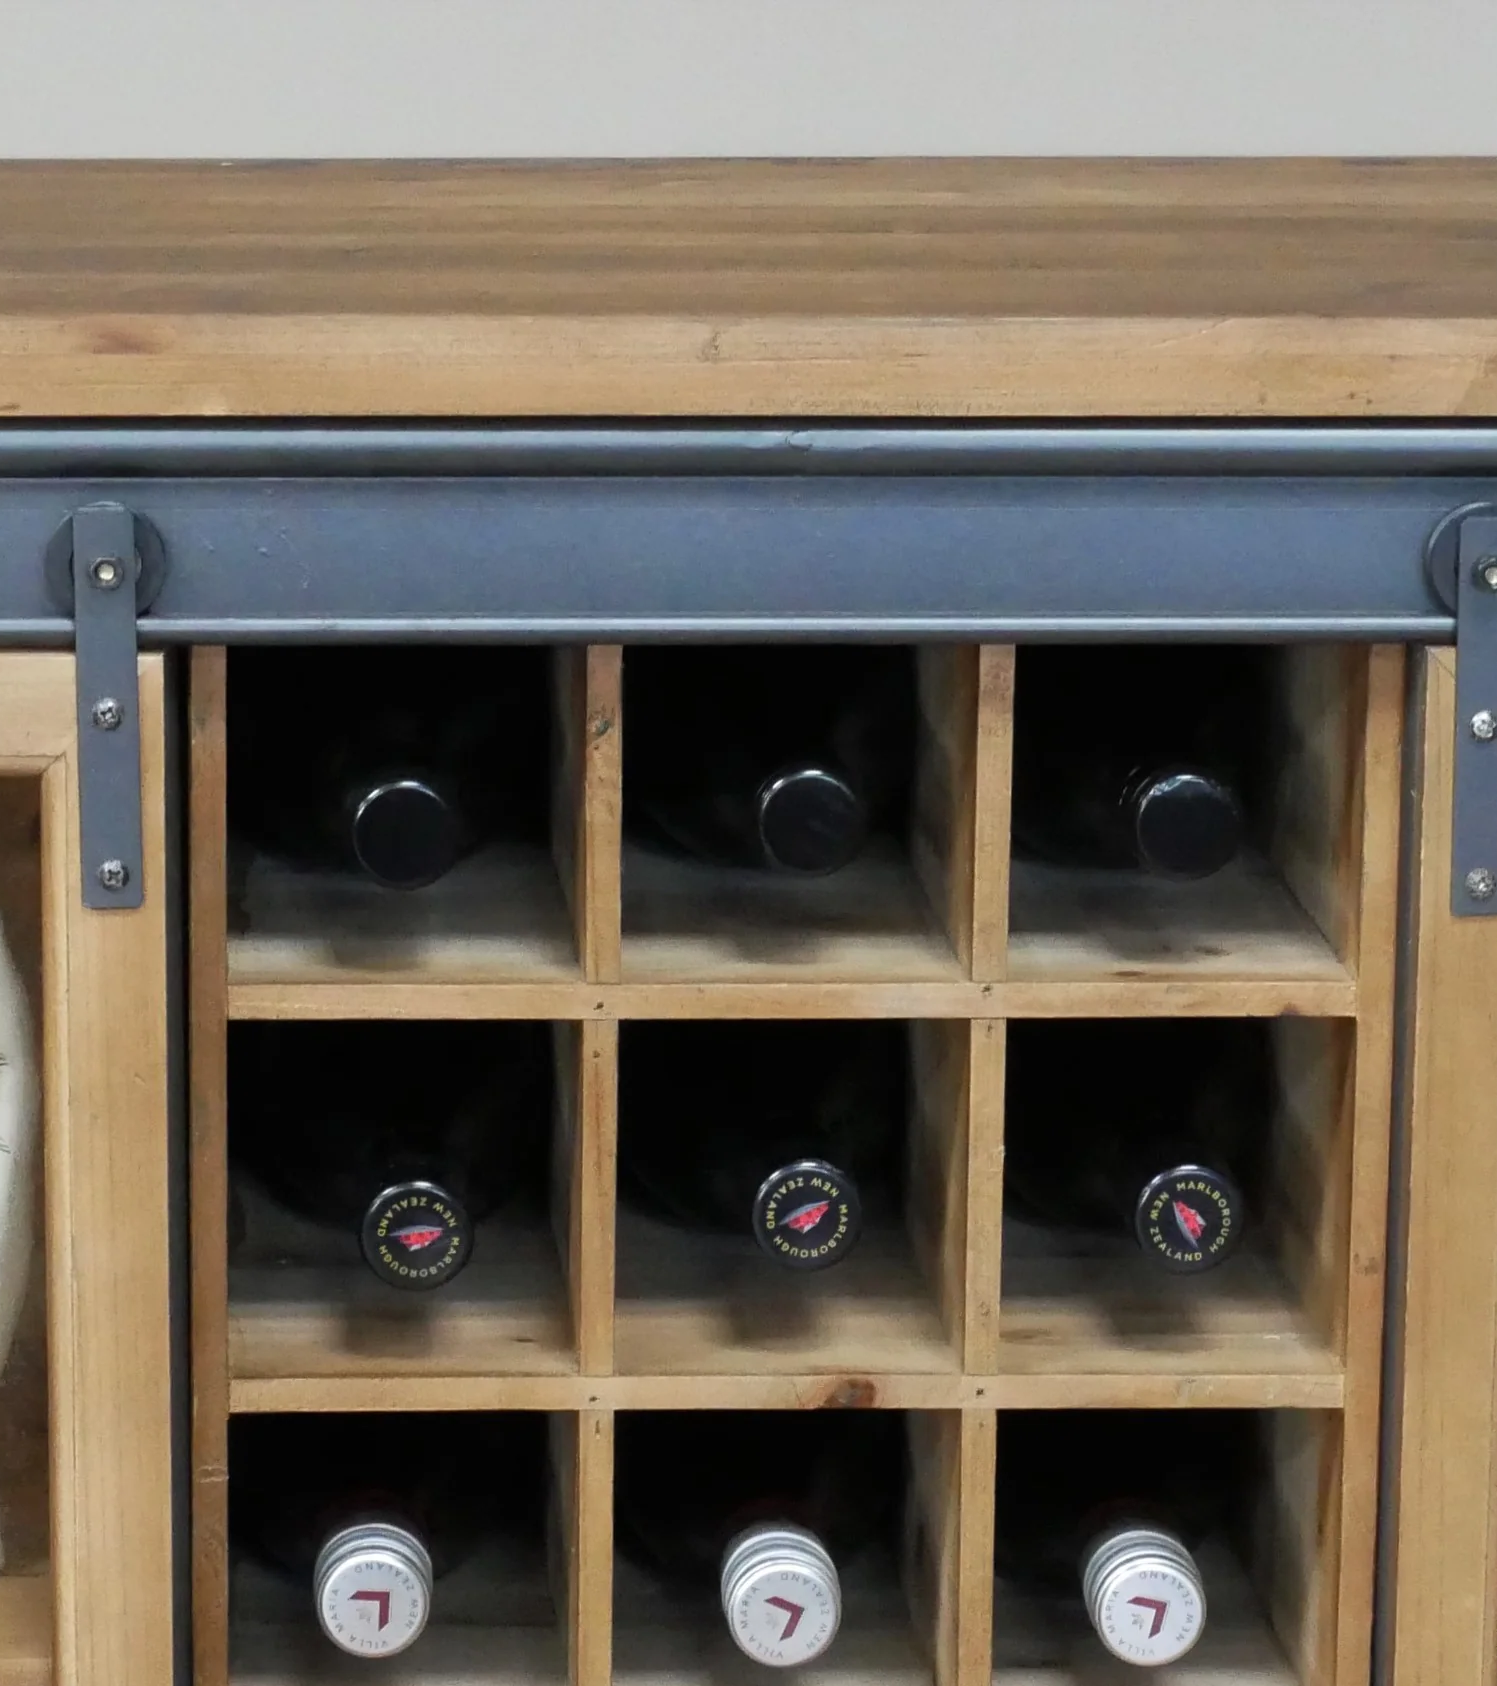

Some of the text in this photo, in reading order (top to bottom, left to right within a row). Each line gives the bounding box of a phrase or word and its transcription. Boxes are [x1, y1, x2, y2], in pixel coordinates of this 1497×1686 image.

[377, 1196, 460, 1278] MARLBOROUGH NEW ZEALAND
[766, 1177, 848, 1258] MARLBOROUGH NEW ZEALAND
[1149, 1181, 1231, 1261] MARLBOROUGH NEW ZEALAND
